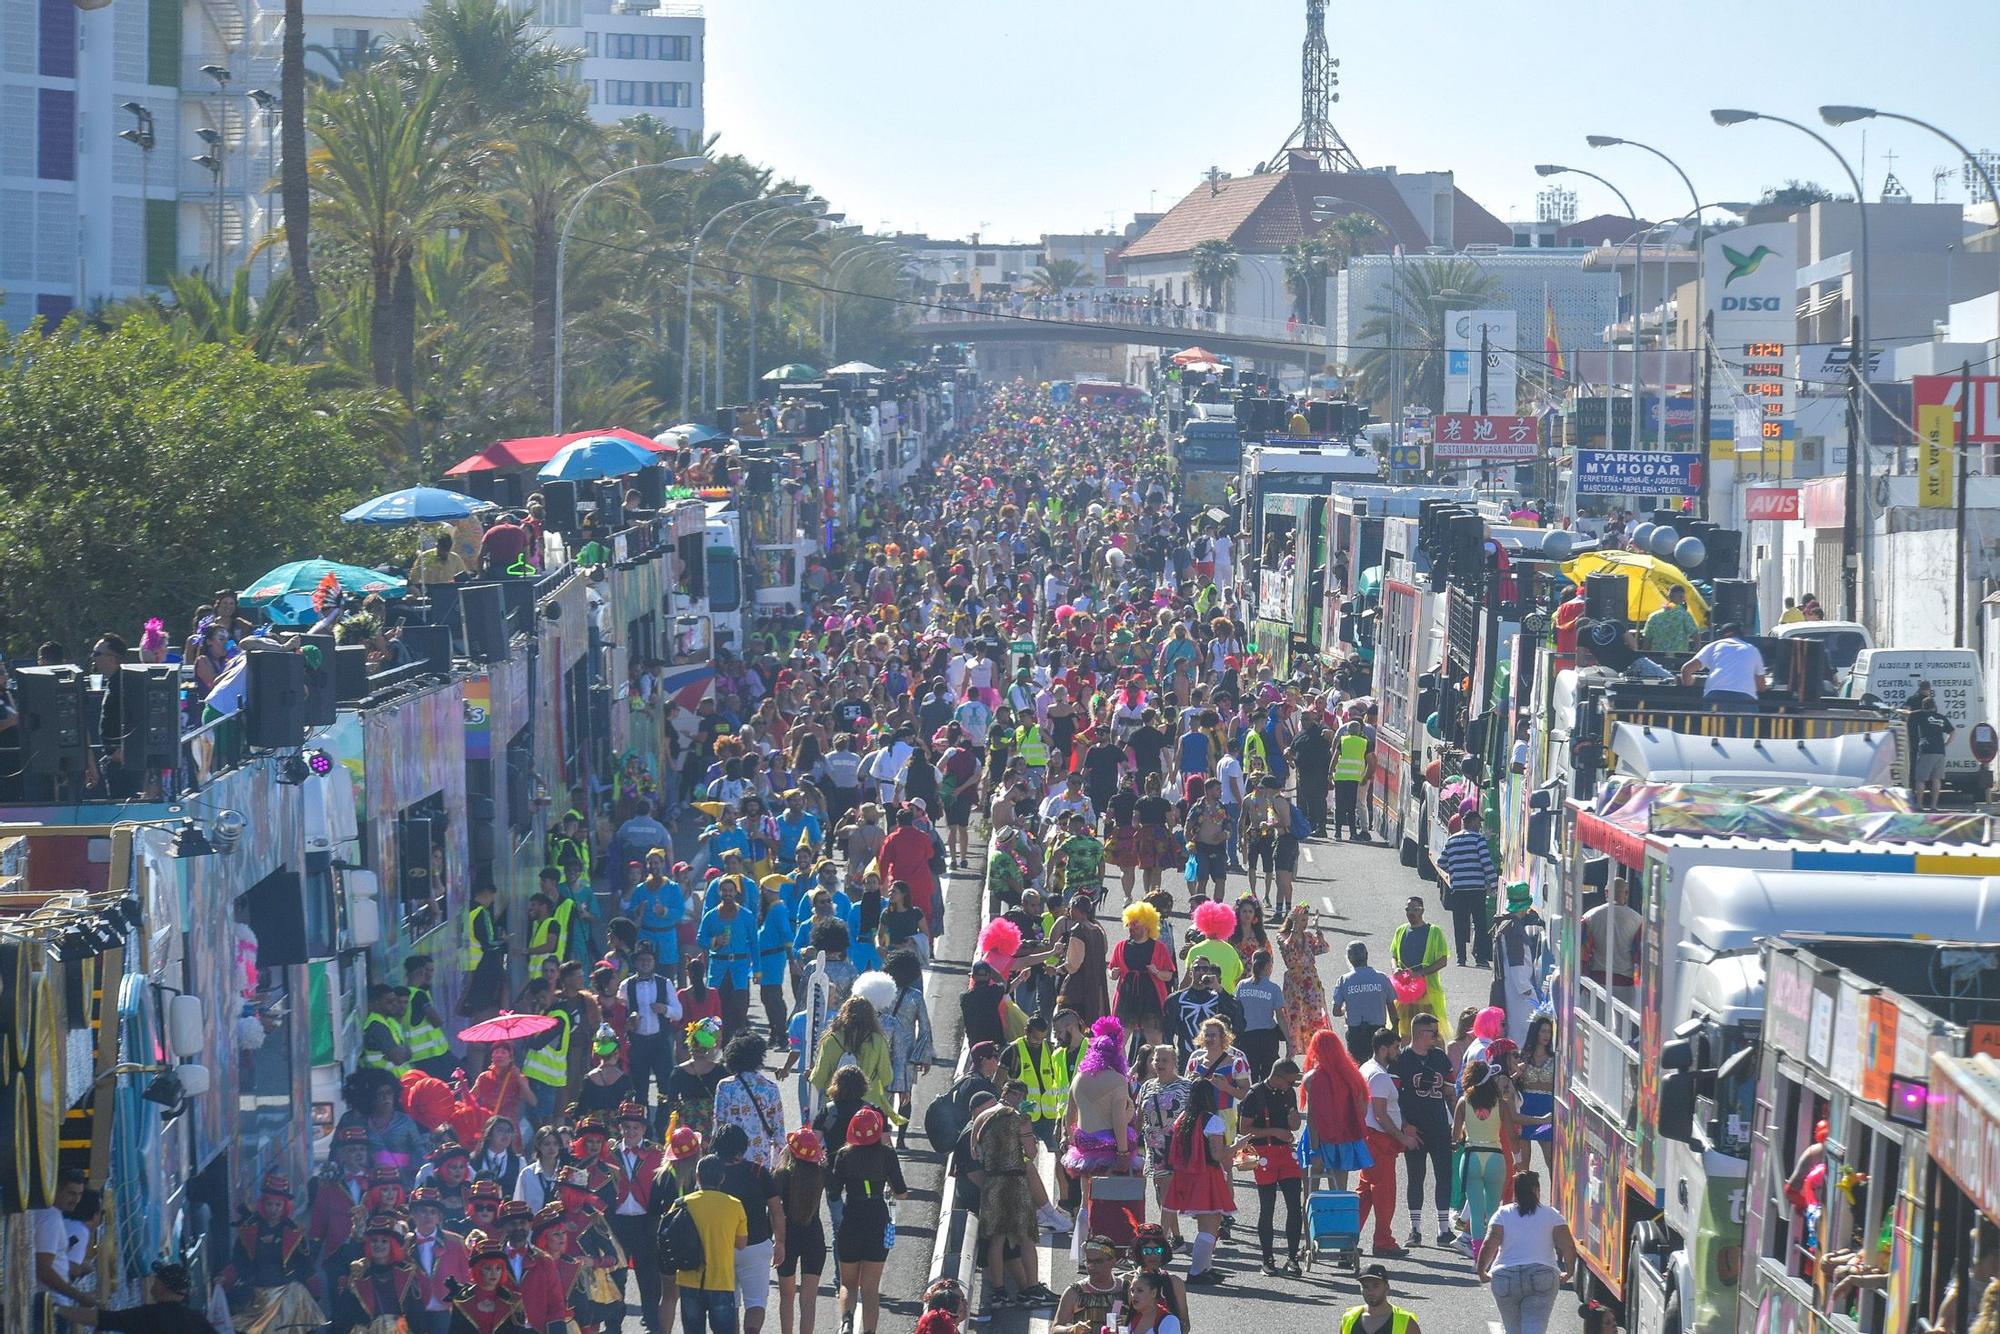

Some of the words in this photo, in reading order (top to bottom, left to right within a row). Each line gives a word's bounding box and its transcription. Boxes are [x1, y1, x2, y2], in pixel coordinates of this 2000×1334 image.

[1763, 422, 1780, 437] 85
[1503, 445, 1534, 454] ANTIGUA
[1594, 453, 1673, 463] PARKING
[1586, 463, 1610, 474] MY
[1617, 464, 1680, 475] HOGAR
[1751, 495, 1796, 513] AVIS
[1877, 680, 1913, 688] CENTRAL
[1883, 690, 1906, 699] 928
[1943, 689, 1966, 698] 034
[1943, 700, 1966, 709] 729
[1945, 711, 1967, 720] 401
[1945, 760, 1977, 768] AN.ES
[1239, 988, 1272, 1000] SEGURIDAD
[1347, 983, 1382, 995] SEGURIDAD
